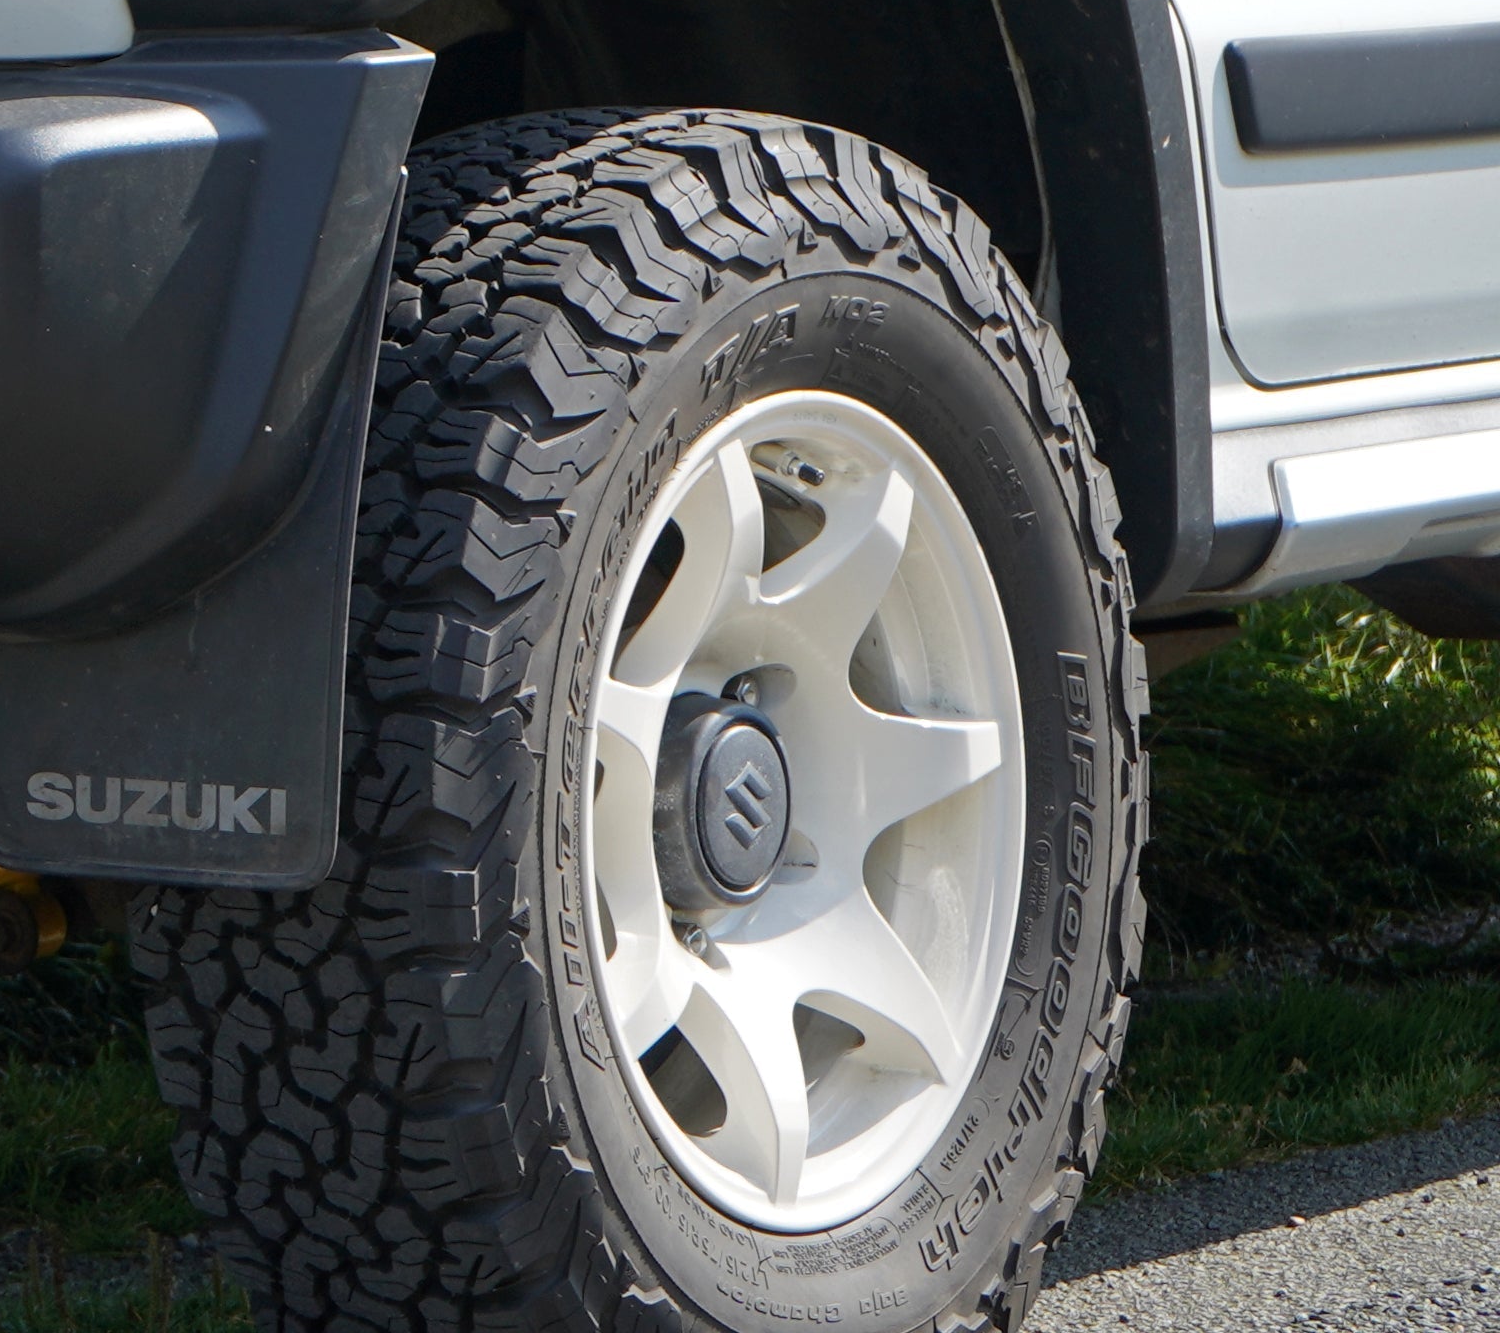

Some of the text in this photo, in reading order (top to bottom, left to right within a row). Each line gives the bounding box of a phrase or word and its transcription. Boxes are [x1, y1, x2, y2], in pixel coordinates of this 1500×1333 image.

[818, 294, 891, 328] KO2
[25, 771, 287, 834] SUZUKI
[917, 650, 1098, 1272] BFGoodrich
[716, 1280, 846, 1325] Champion
